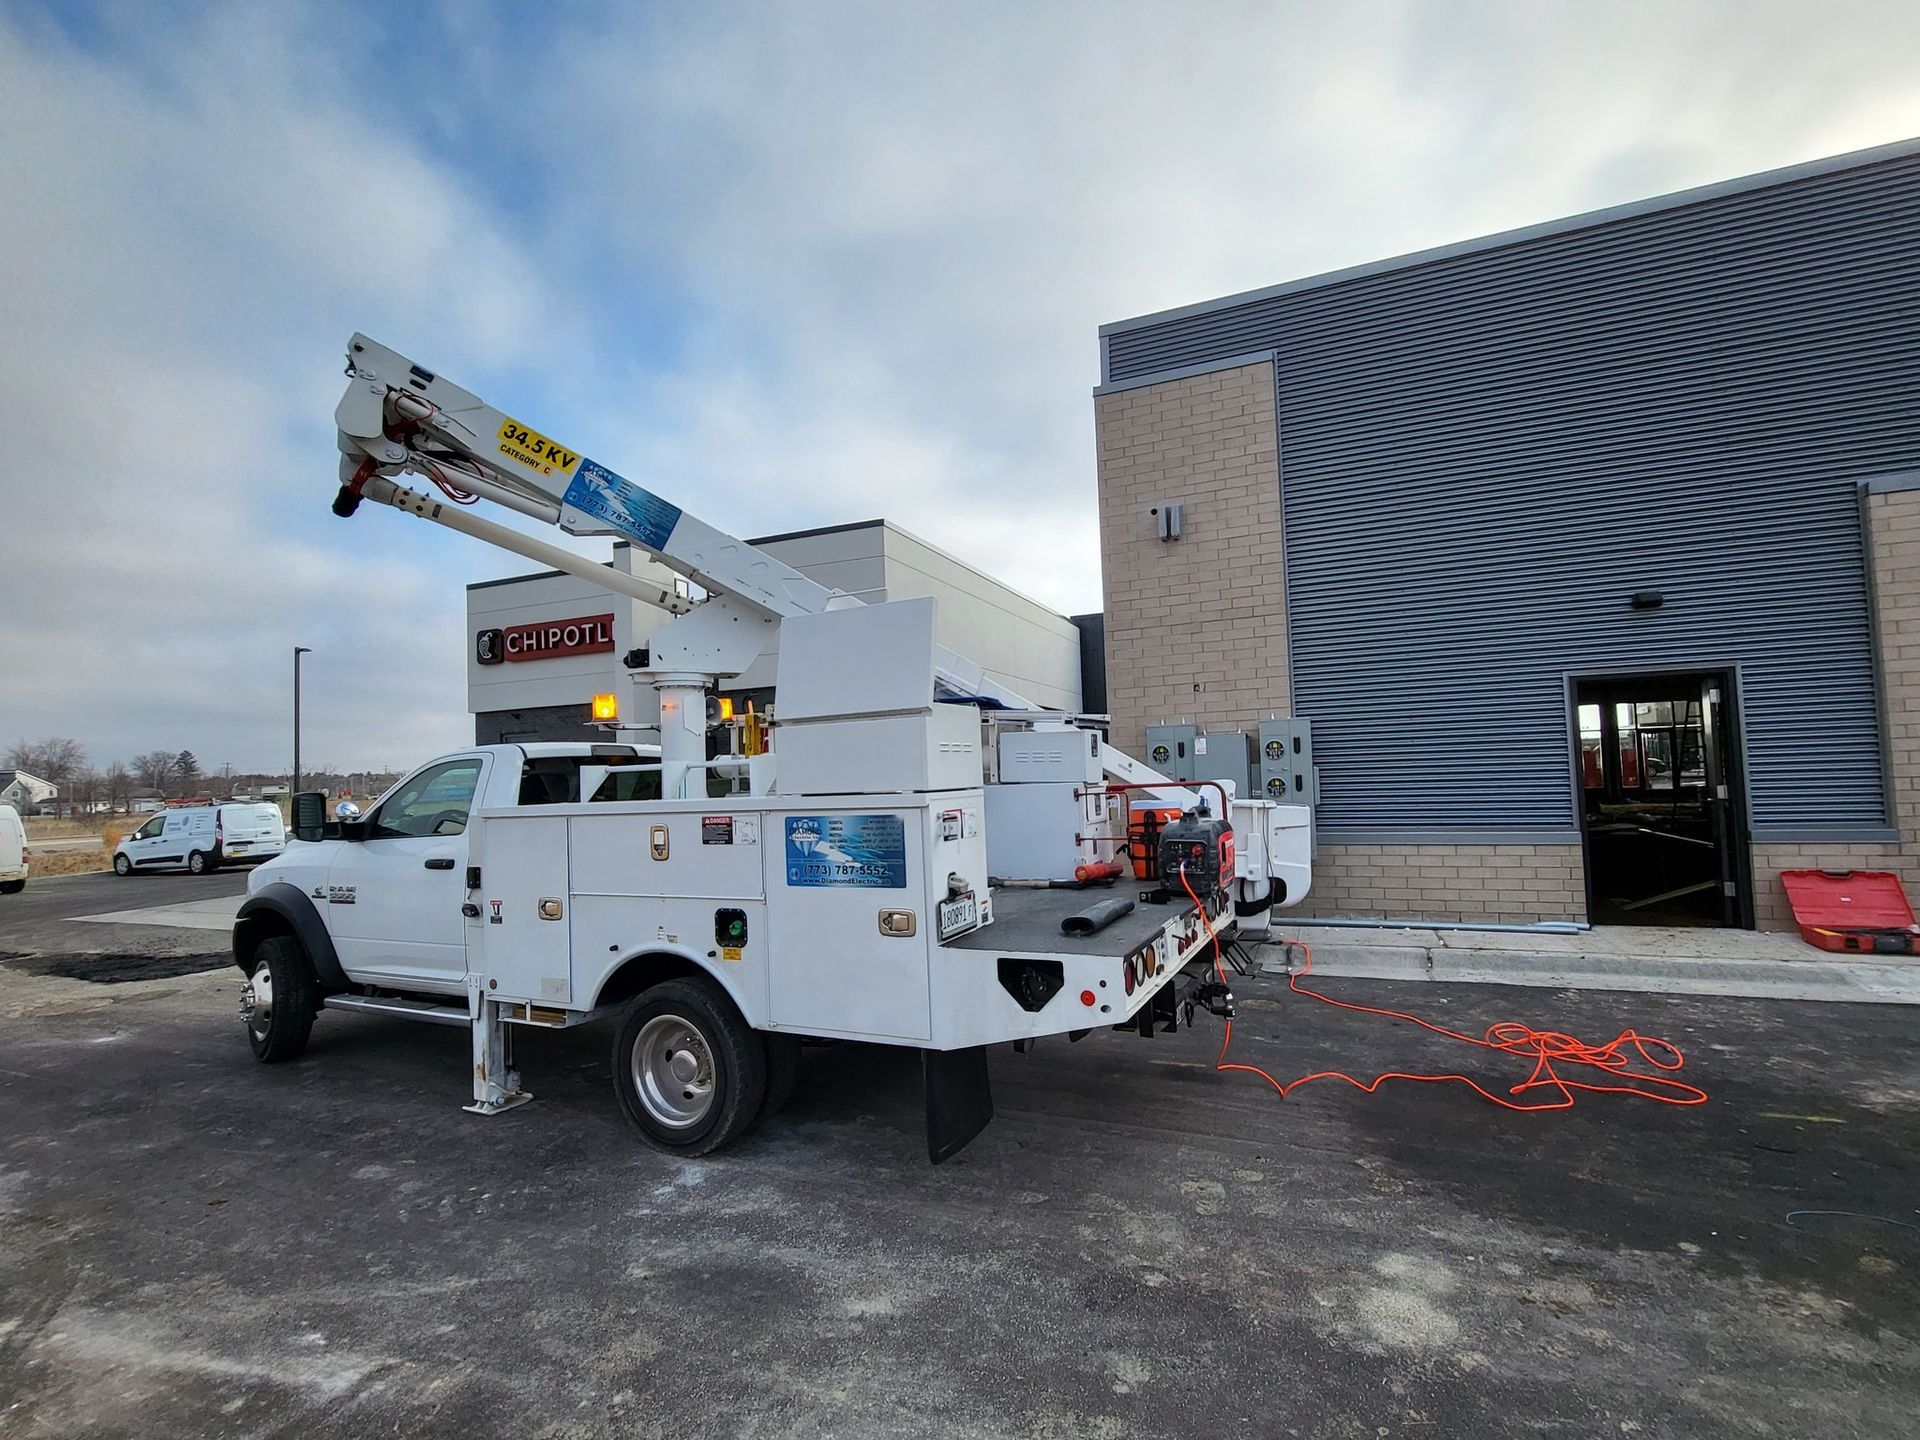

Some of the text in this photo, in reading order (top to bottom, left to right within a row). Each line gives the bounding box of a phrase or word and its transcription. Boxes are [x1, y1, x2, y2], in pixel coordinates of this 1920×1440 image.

[500, 444, 551, 474] CATEGORY C
[503, 424, 576, 468] 34.5 KV
[506, 621, 615, 653] CHIPOTL
[804, 865, 888, 876] (773) 787-5552
